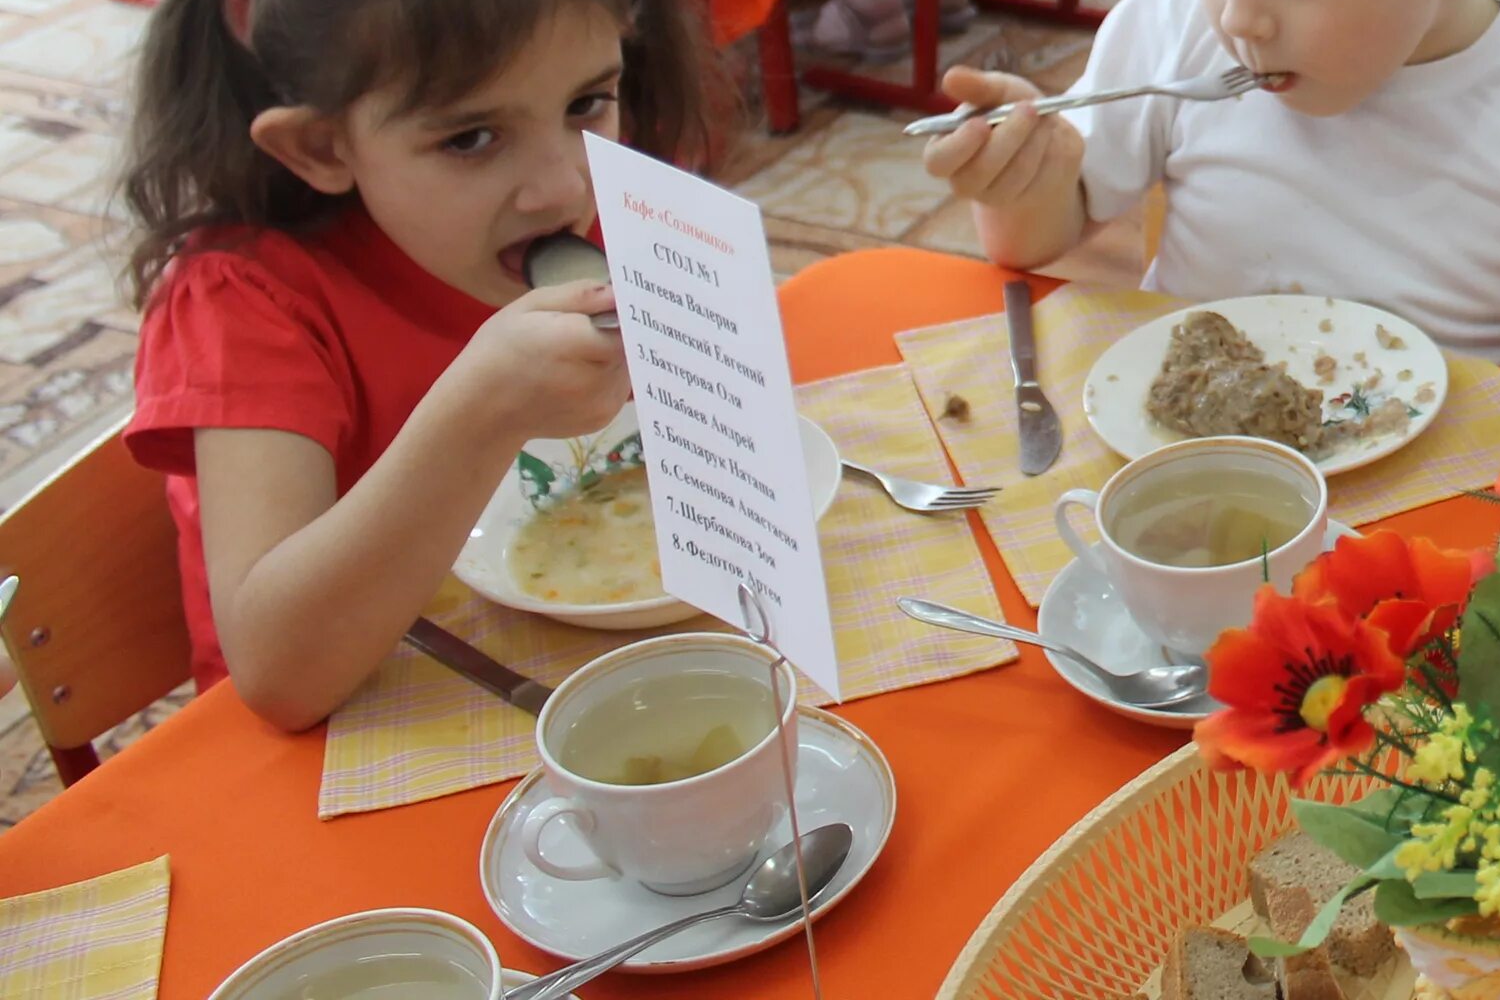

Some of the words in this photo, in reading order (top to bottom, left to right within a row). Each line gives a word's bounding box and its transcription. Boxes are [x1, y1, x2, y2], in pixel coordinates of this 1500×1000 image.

[623, 191, 654, 220] Кафе
[653, 242, 695, 276] СТОЛ
[685, 293, 738, 335] Валерия
[714, 344, 766, 388] Евгений
[716, 382, 743, 410] Оля
[711, 414, 755, 454] Андрей
[728, 458, 776, 502] Наташа
[738, 498, 799, 552] Анастасия
[755, 541, 777, 569] Зоя
[748, 569, 783, 607] Артем
